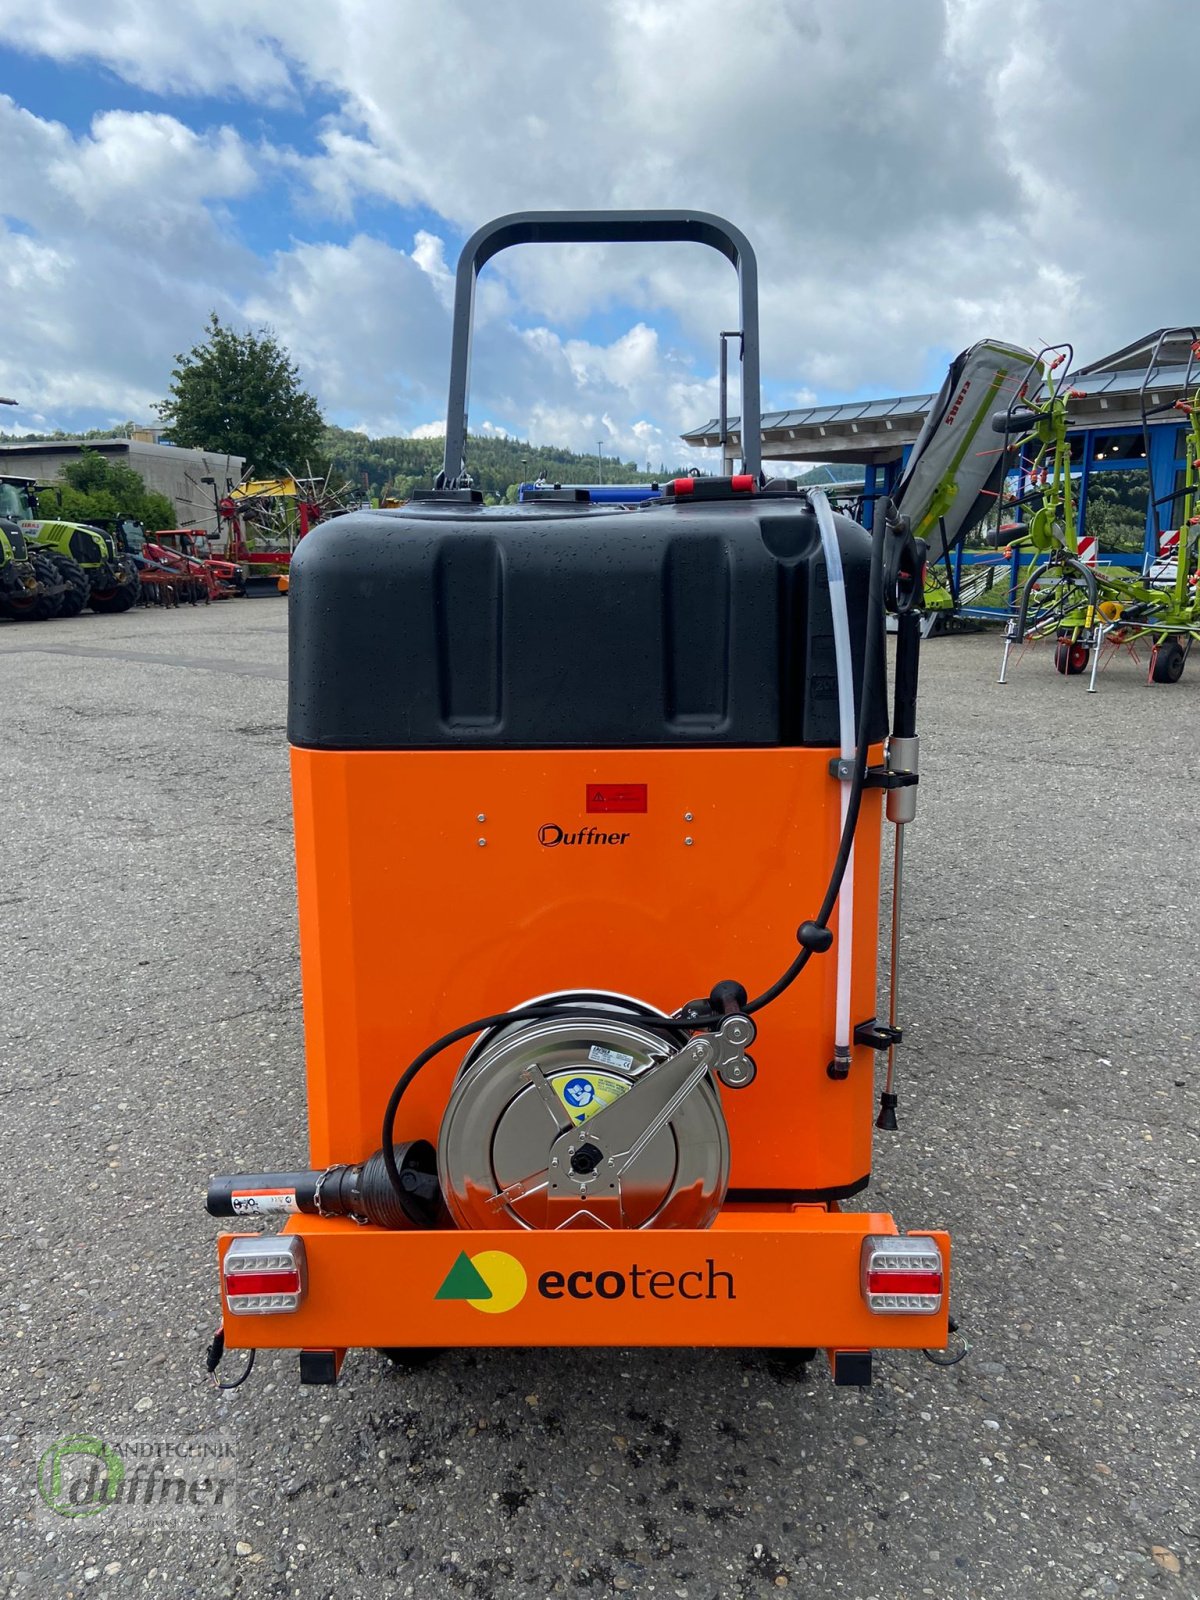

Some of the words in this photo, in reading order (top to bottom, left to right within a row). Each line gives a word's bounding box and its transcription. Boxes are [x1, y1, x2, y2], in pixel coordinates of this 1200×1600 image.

[945, 381, 971, 425] CLAAS
[538, 823, 630, 847] Duffner
[537, 1259, 736, 1299] ecotech
